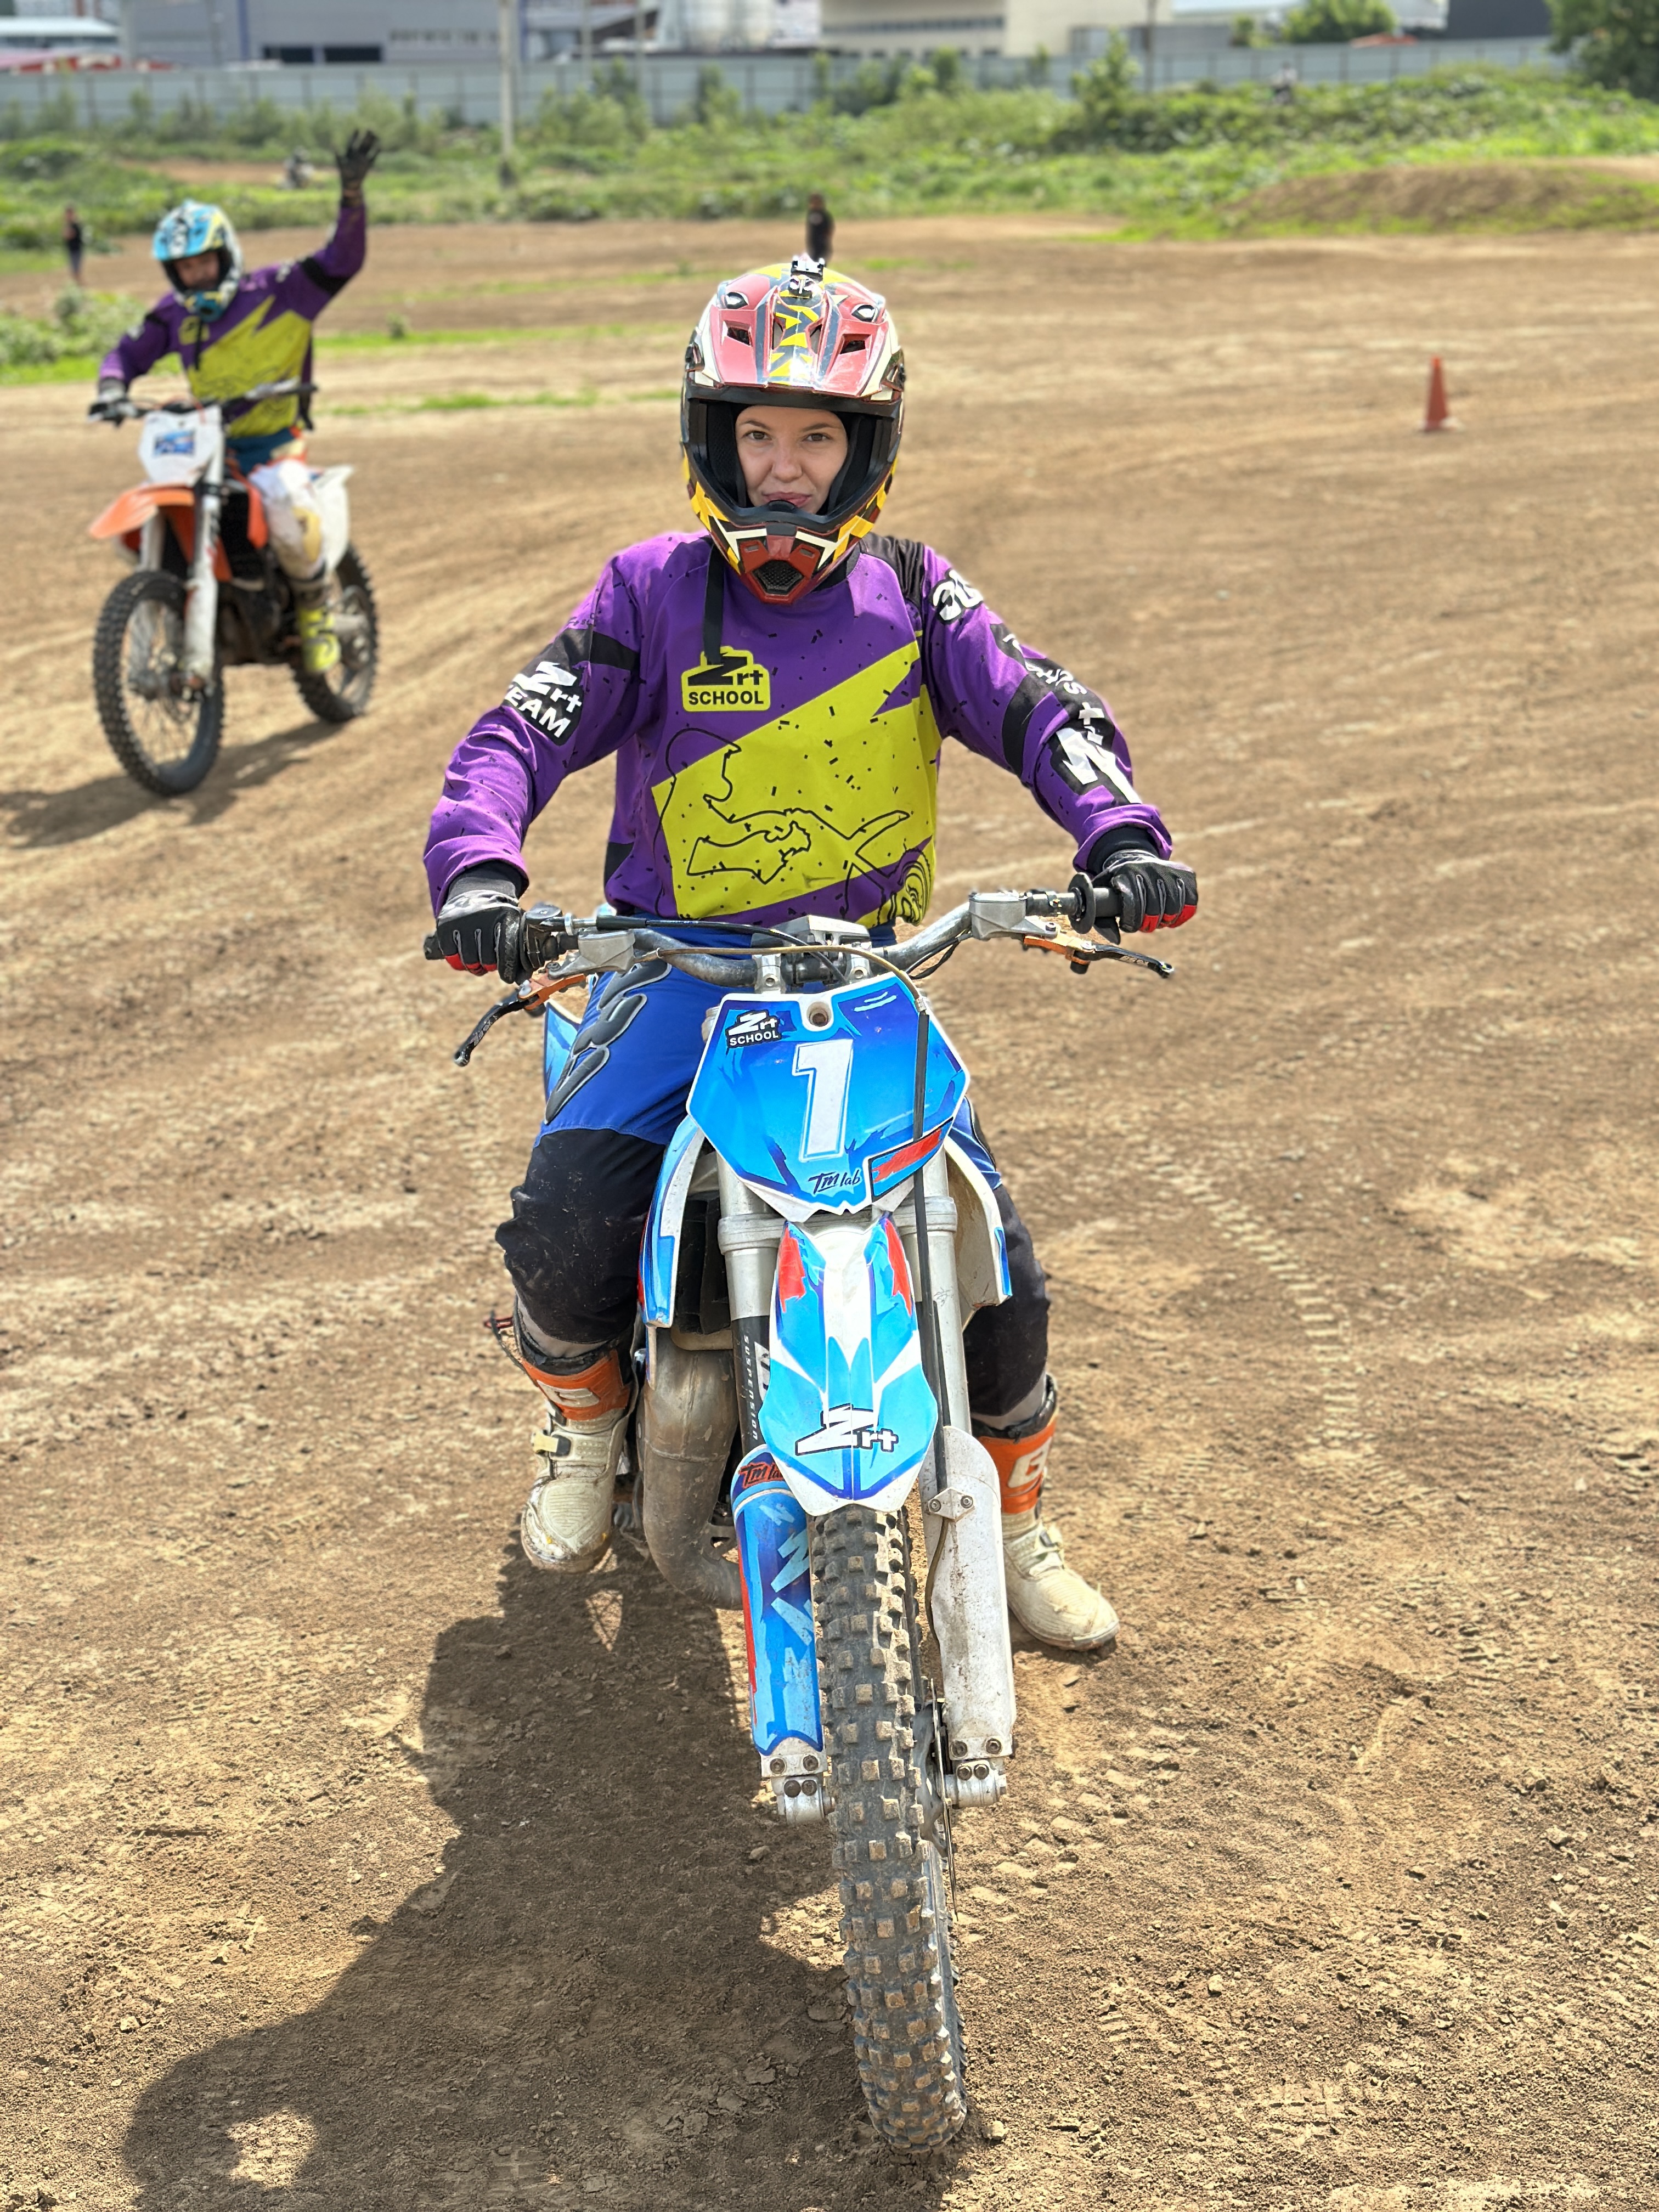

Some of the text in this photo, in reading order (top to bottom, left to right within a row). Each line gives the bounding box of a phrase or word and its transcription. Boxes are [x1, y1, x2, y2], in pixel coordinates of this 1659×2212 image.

[512, 661, 582, 713] Zrt
[688, 652, 763, 686] Zrt
[504, 685, 571, 738] EAM
[689, 691, 764, 705] SCHOOL
[728, 1012, 777, 1036] Zrt
[730, 1030, 778, 1046] SCHOOL
[792, 1039, 854, 1163] 1
[795, 1403, 899, 1455] Zrt
